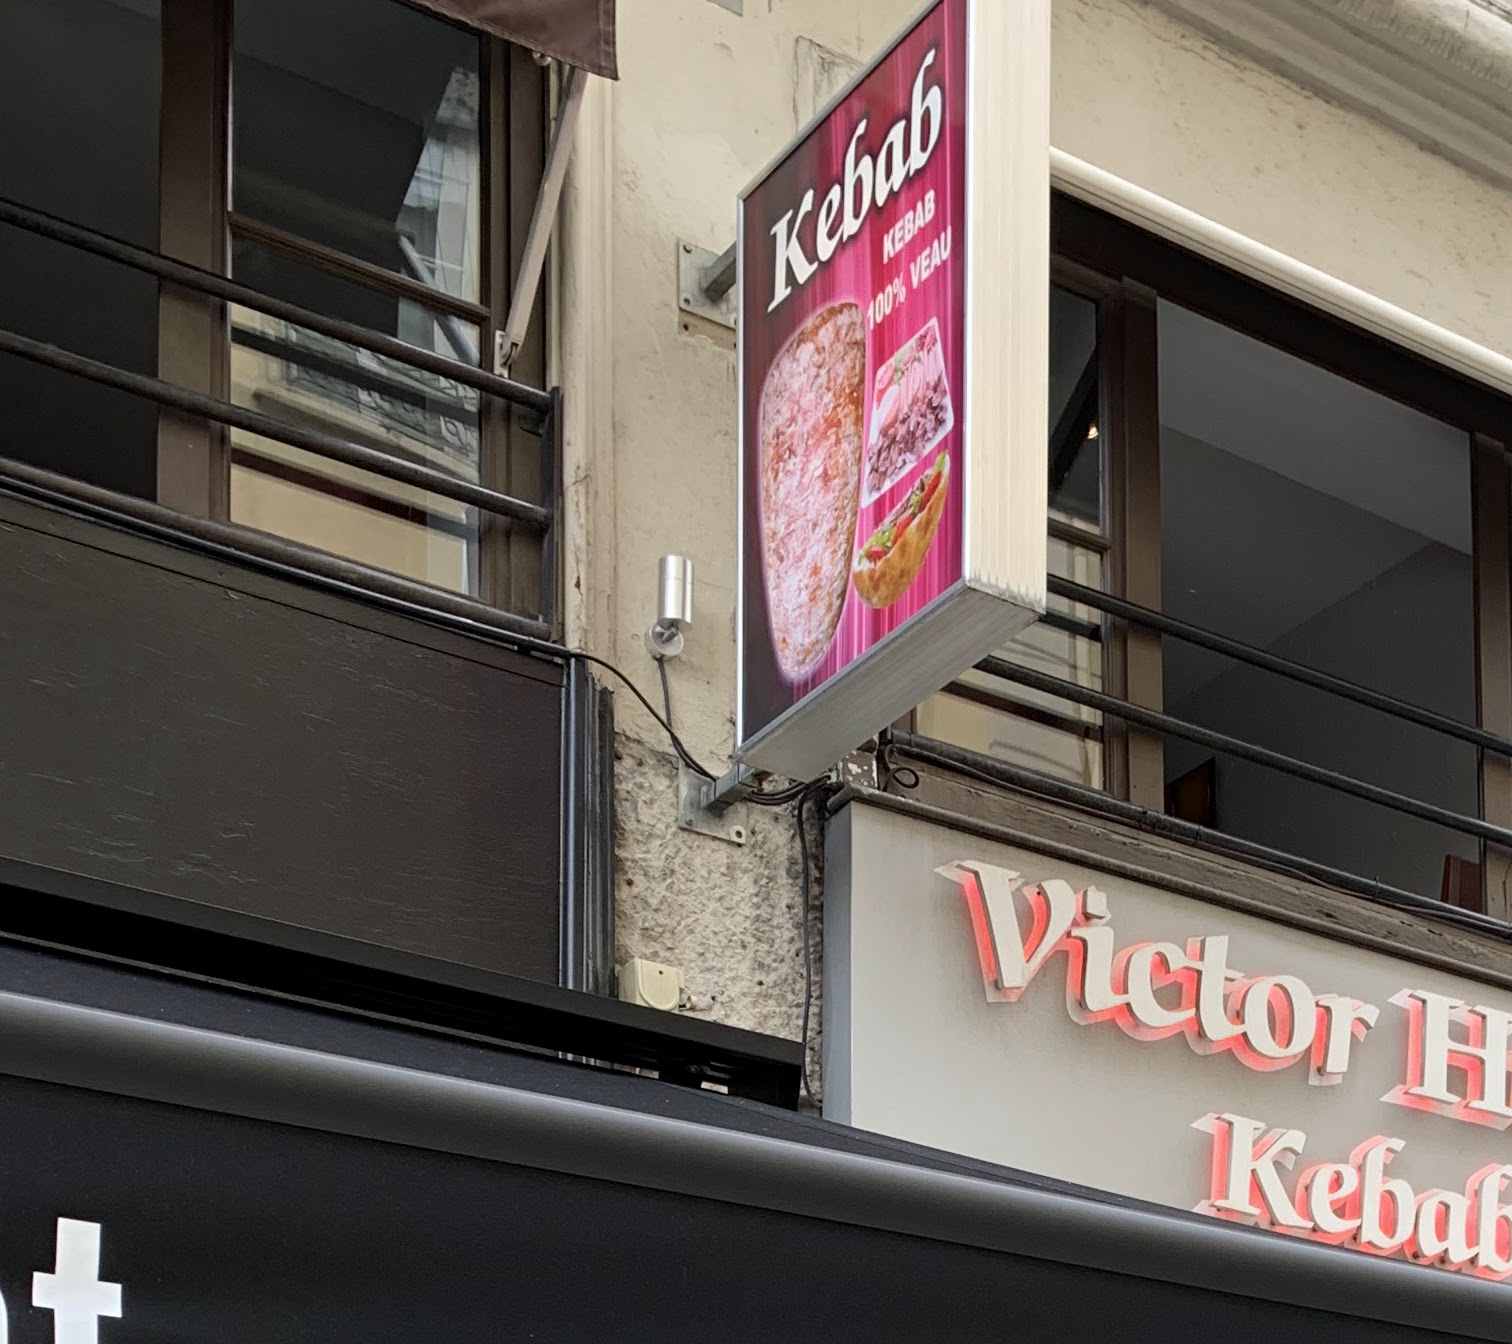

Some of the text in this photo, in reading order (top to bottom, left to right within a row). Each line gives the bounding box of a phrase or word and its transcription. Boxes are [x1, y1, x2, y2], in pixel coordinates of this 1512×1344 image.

[767, 48, 942, 313] Kebab
[882, 189, 935, 265] KEBAB
[867, 225, 952, 330] 100% VEAU
[935, 859, 1381, 1086] Victor
